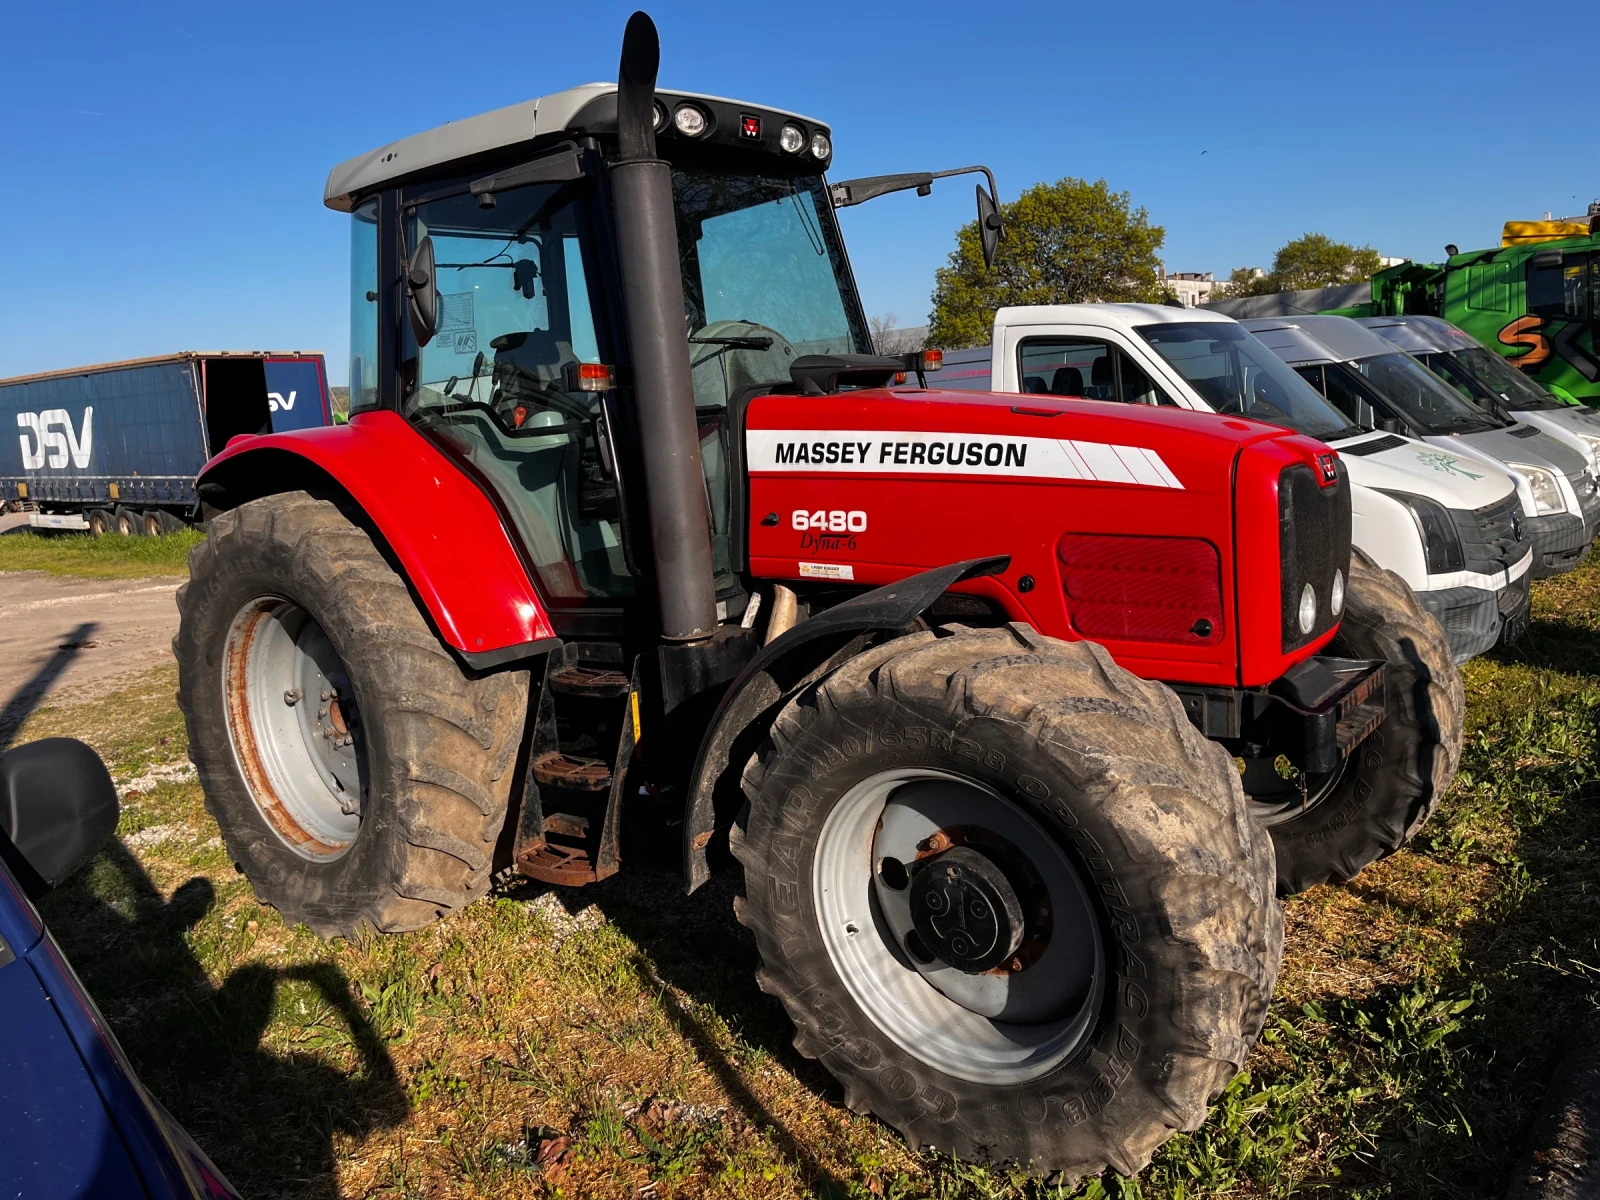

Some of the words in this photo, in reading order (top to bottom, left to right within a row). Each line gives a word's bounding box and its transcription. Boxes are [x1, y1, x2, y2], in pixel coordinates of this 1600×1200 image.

[267, 391, 297, 412] SV
[17, 406, 94, 470] DSV
[774, 442, 872, 465] MASSEY
[878, 441, 1028, 468] FERGUSON
[791, 509, 868, 533] 6480
[800, 532, 858, 555] Dyna-6
[811, 724, 1007, 781] 480/65R28
[1015, 774, 1149, 1020] OPTITRAC
[1061, 1023, 1141, 1128] DT818
